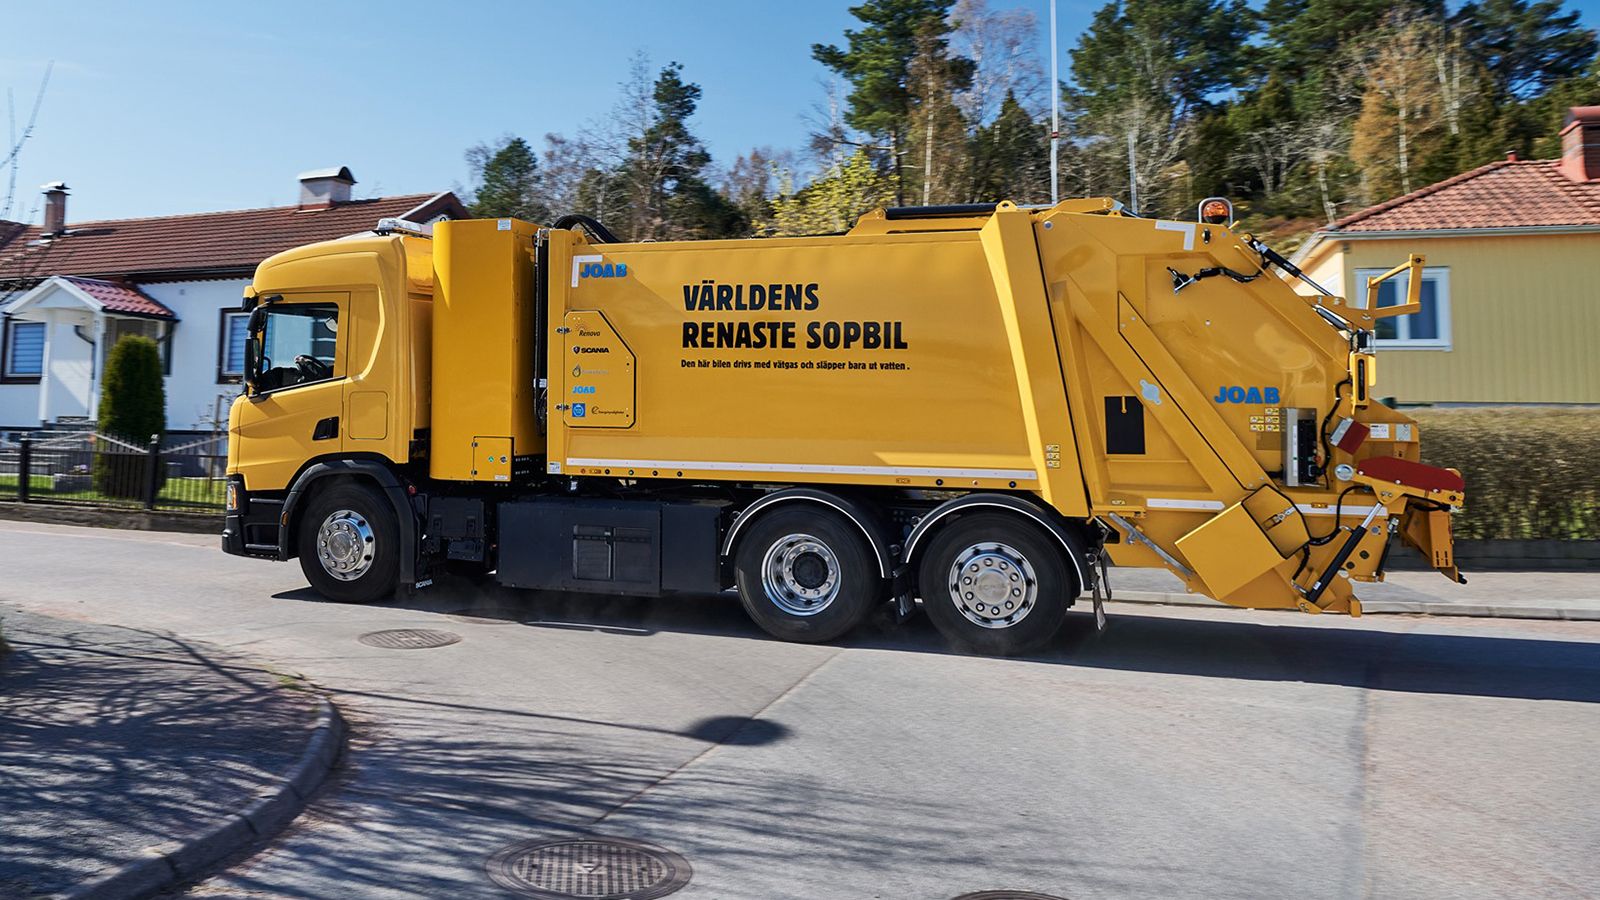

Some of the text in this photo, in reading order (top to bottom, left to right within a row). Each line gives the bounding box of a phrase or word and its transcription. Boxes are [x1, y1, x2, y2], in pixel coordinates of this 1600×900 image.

[580, 263, 628, 278] JOAB
[683, 280, 820, 311] VÄRLDENS
[682, 321, 909, 350] RENASTE SOPBIL
[681, 359, 696, 368] Den
[697, 359, 711, 368] här
[712, 360, 732, 368] bilen
[733, 360, 752, 369] drivs
[754, 360, 771, 369] med
[773, 360, 799, 370] vätgas
[800, 361, 814, 369] och
[816, 361, 847, 371] släpper
[848, 361, 867, 370] bara
[868, 361, 878, 370] ut
[572, 386, 596, 394] JOAB
[1214, 386, 1281, 404] JOAB
